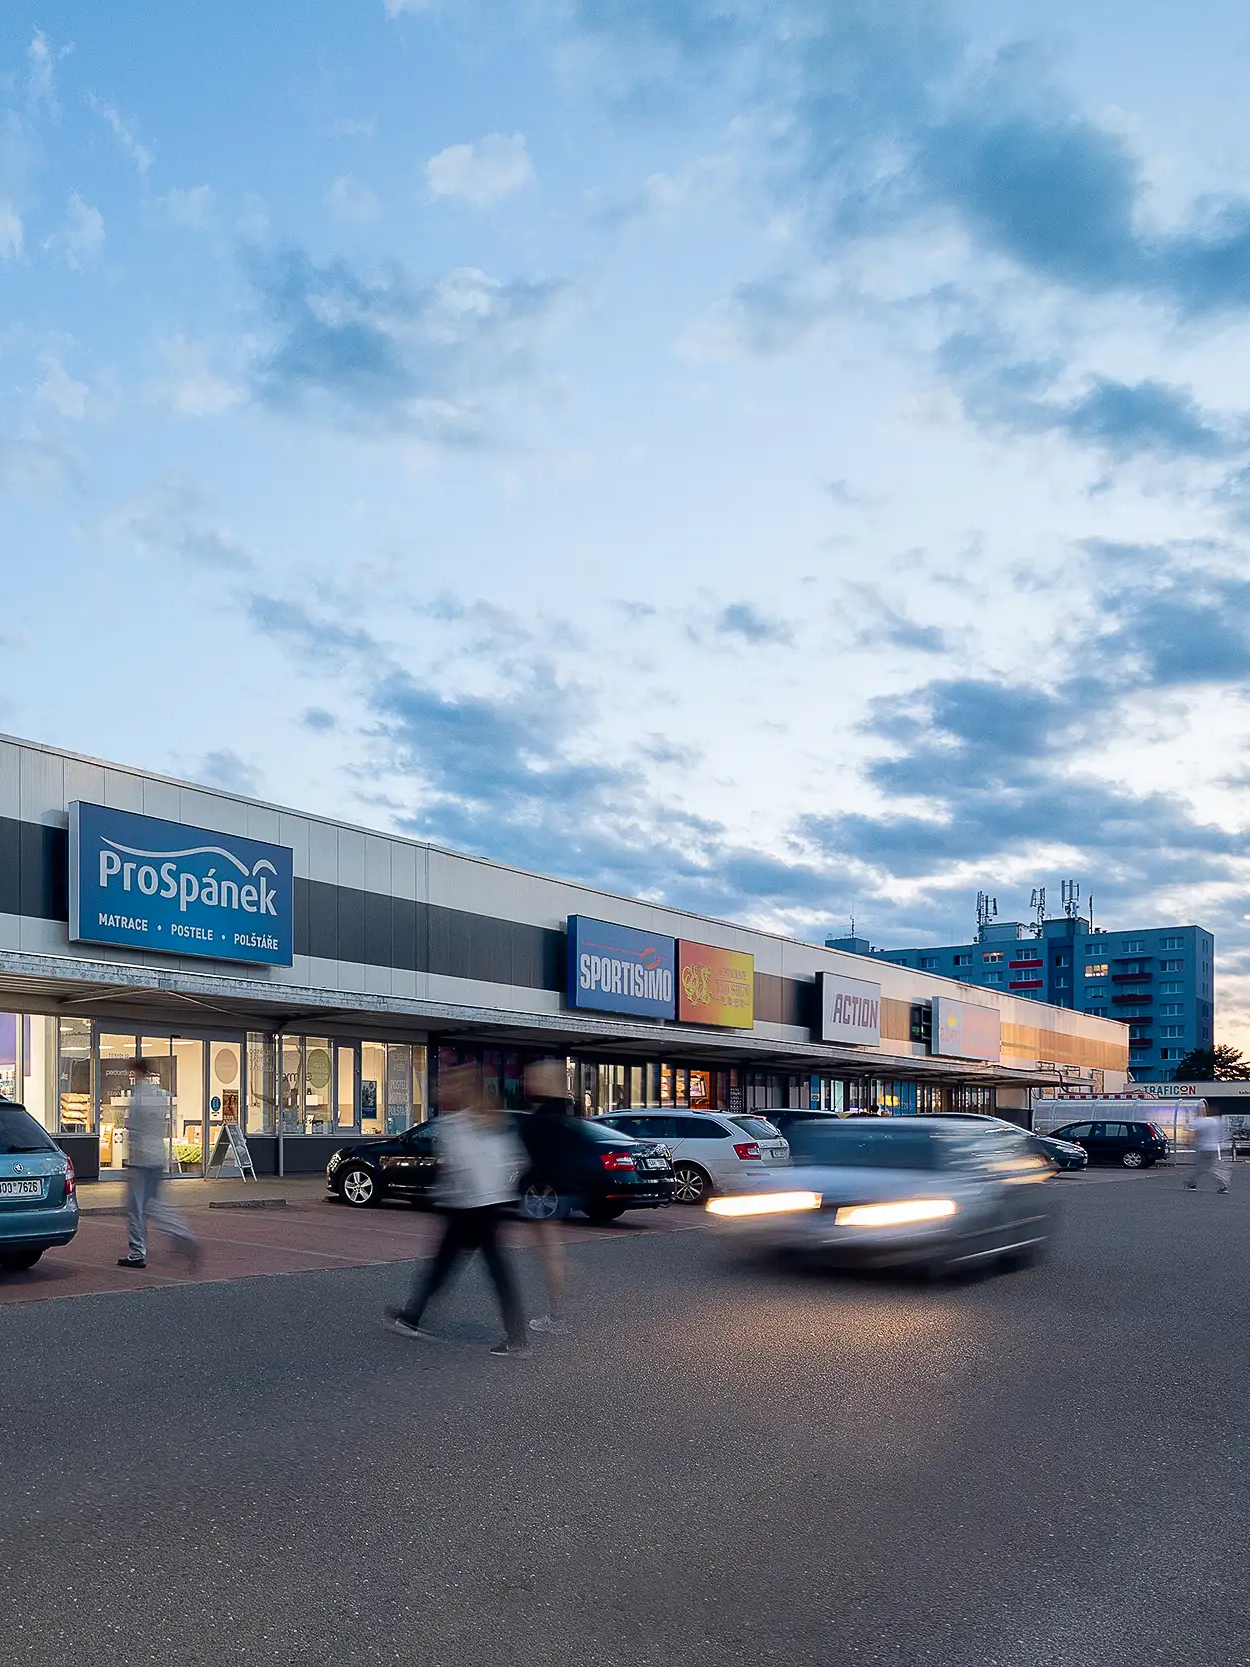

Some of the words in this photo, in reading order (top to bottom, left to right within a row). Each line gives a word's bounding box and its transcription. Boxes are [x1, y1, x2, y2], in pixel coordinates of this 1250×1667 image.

[99, 850, 278, 916] ProSpánek
[98, 913, 148, 932] MATRACE
[171, 924, 214, 941] POSTELE
[234, 932, 279, 950] POLŠTÁŘE
[580, 953, 672, 1002] SPORTISIMO
[833, 993, 879, 1029] ACTION
